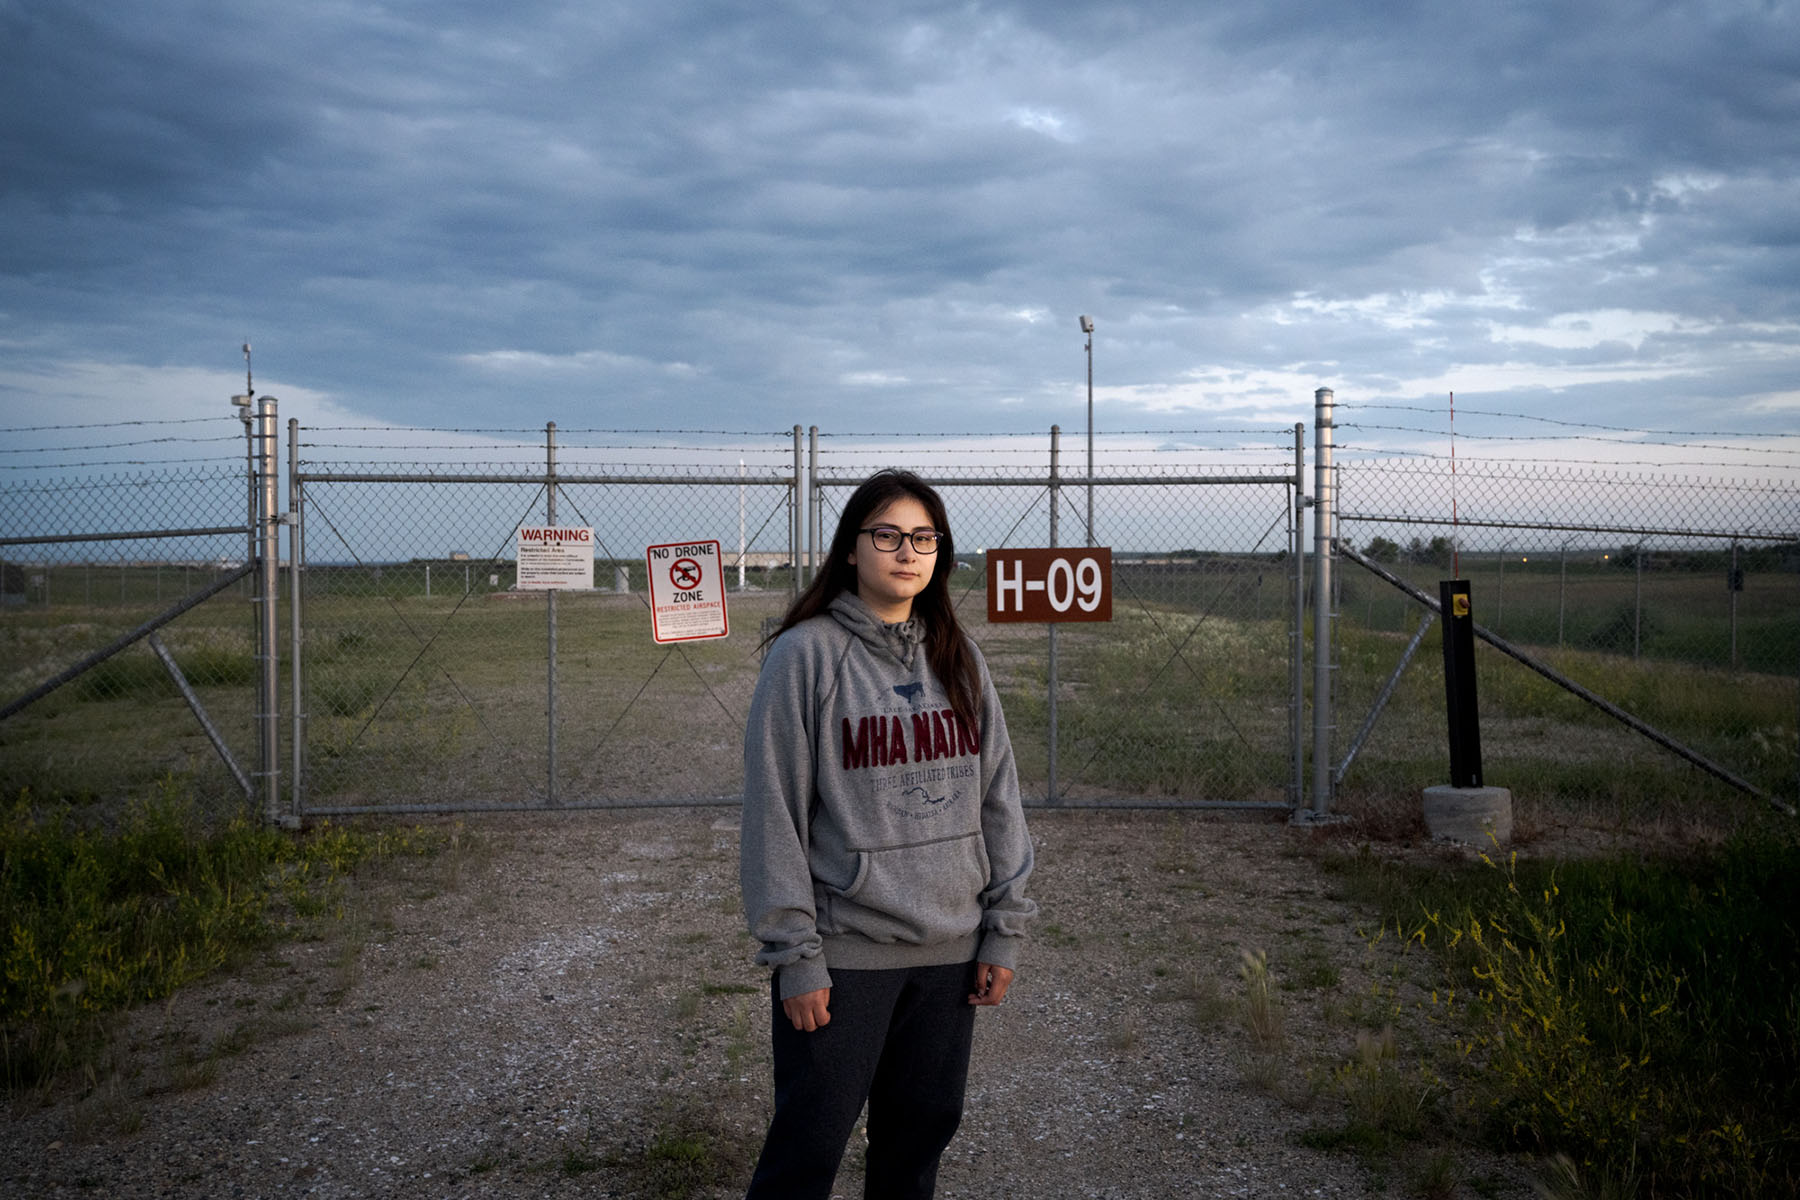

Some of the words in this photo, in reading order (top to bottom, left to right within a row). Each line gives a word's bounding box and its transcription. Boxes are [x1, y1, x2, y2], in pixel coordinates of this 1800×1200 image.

[521, 529, 589, 541] WARNING
[653, 548, 669, 560] NO
[675, 544, 714, 558] DRONE
[996, 557, 1103, 613] H-09
[673, 590, 704, 603] ZONE
[656, 604, 691, 613] RESTRICTED
[693, 601, 721, 610] AIRSPACE
[842, 715, 908, 771] MHA
[870, 775, 898, 793] THREE
[900, 767, 945, 788] AFFILIATED
[947, 764, 976, 780] TRIBES
